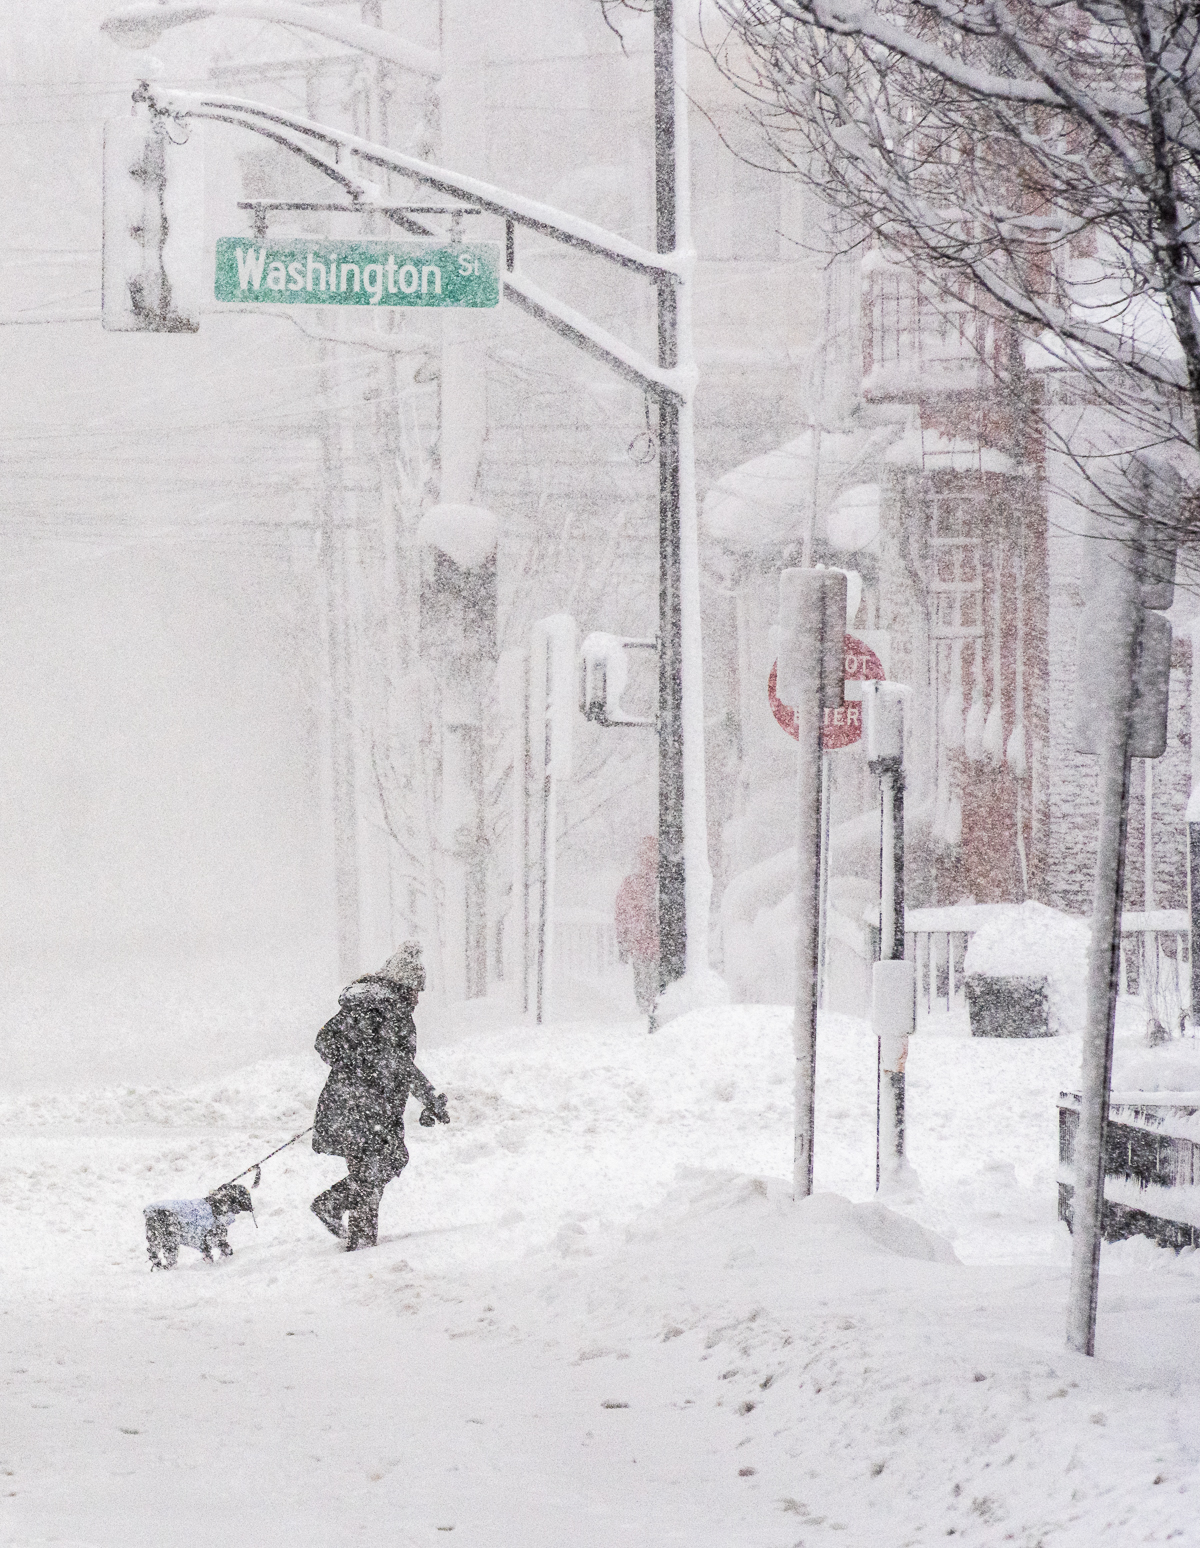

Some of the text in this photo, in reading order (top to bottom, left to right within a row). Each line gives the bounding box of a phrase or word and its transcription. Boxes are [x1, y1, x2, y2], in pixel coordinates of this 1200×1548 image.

[236, 248, 481, 304] Washington St
[844, 655, 871, 674] OT
